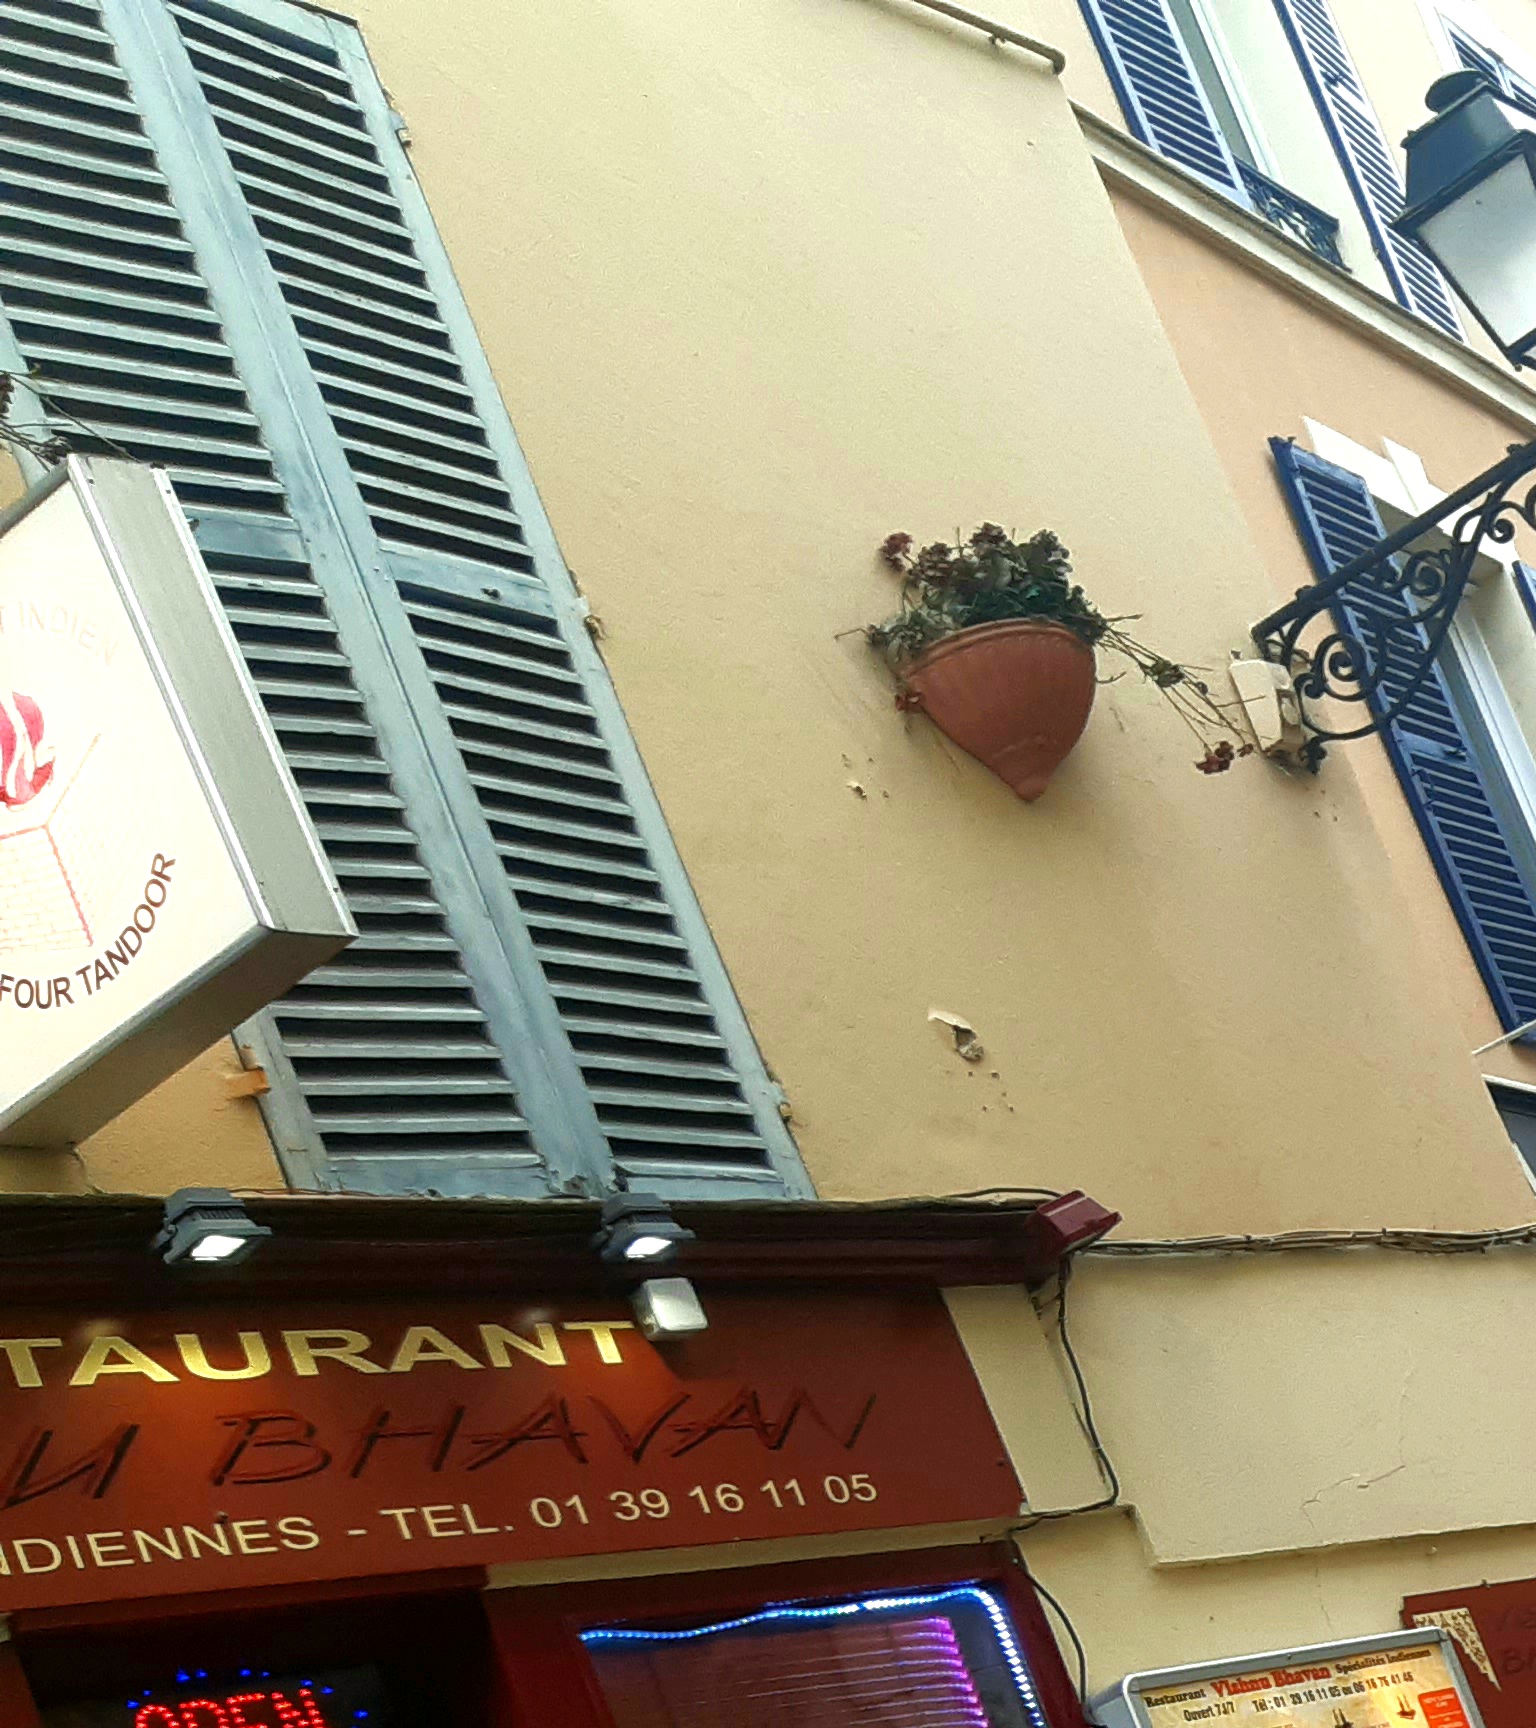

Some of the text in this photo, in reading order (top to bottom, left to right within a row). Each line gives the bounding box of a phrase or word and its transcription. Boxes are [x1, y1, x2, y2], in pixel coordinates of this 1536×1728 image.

[75, 852, 177, 996] TANDOOR
[0, 1320, 635, 1388] TAURANT
[207, 1385, 878, 1488] BHAVAN
[379, 1502, 515, 1541] TEL.
[529, 1493, 591, 1529] 01
[609, 1488, 672, 1522] 39
[688, 1482, 745, 1515] 16
[759, 1477, 807, 1509] 11
[823, 1473, 878, 1504] 05
[1144, 1688, 1207, 1708] Restaurant
